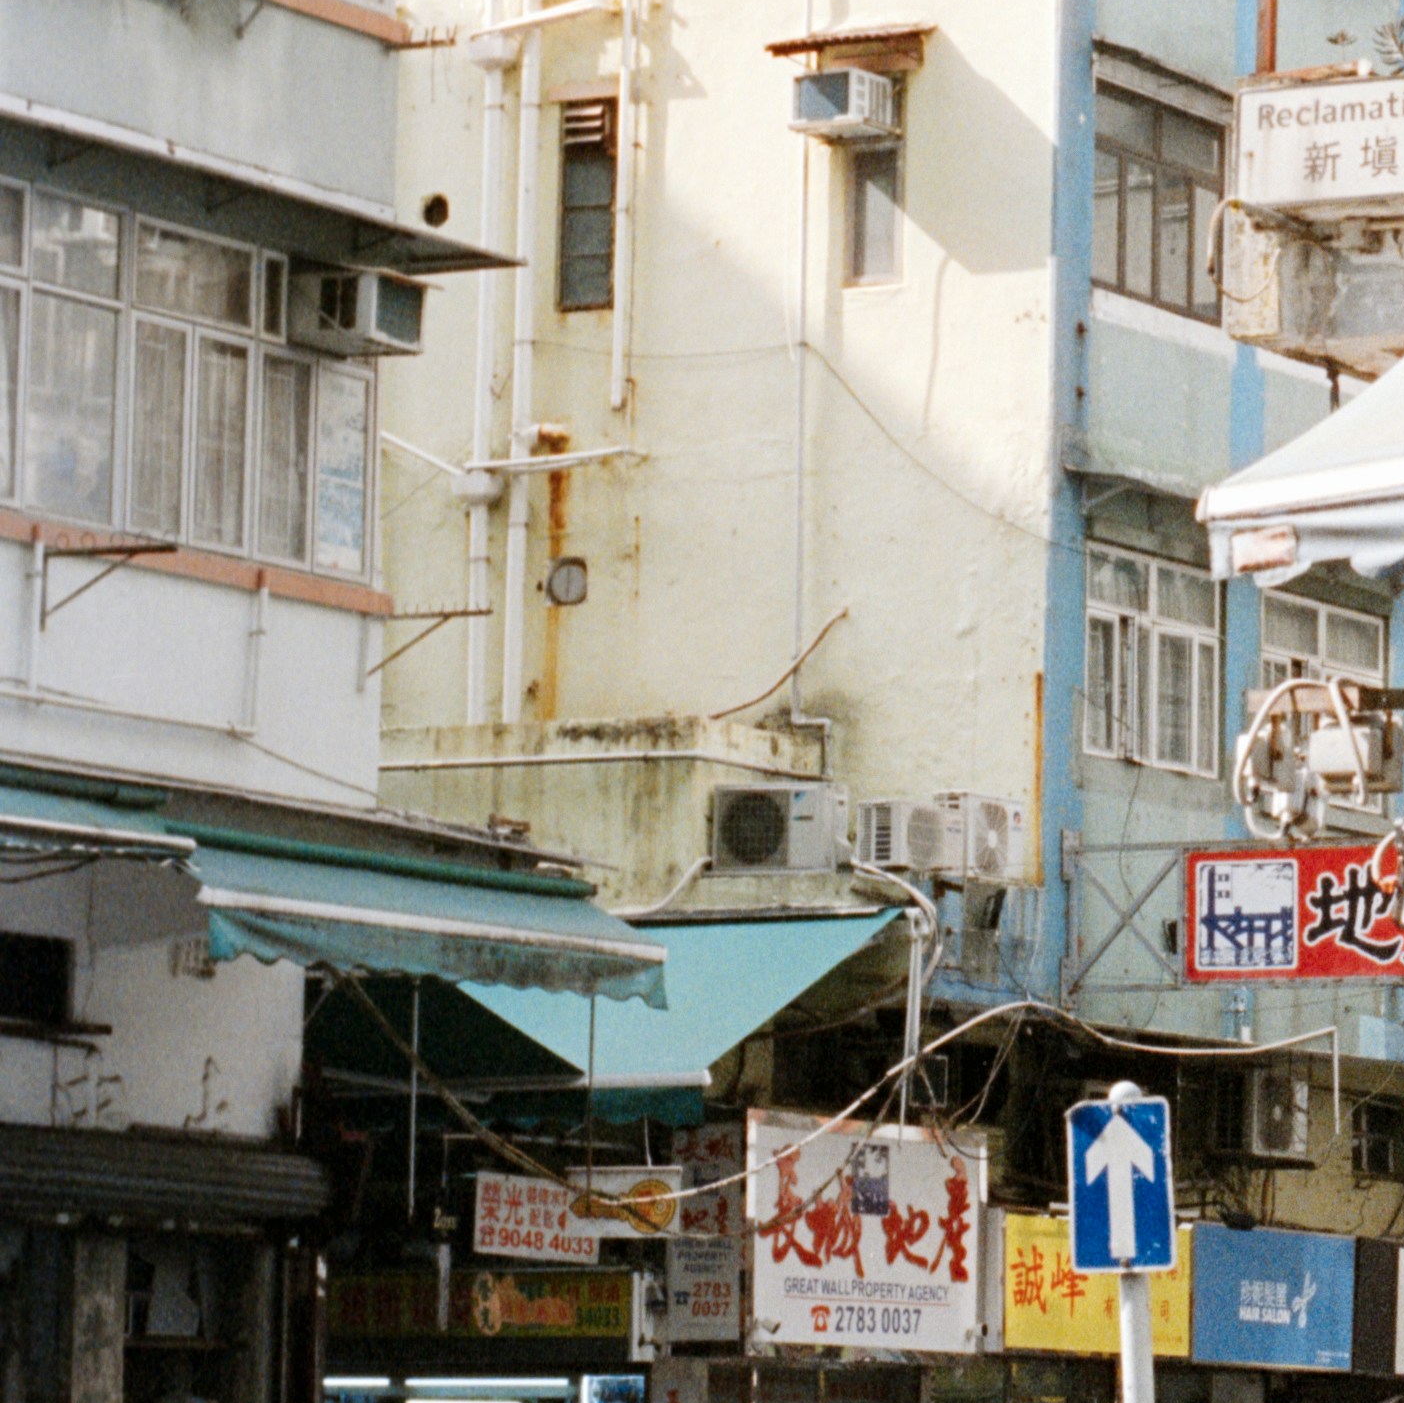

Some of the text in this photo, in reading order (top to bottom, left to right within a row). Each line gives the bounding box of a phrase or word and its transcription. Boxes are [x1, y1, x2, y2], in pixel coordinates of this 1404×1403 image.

[757, 1143, 971, 1284] 長城地產
[498, 1227, 595, 1257] 9048 4033
[692, 1282, 731, 1299] 2783
[784, 1277, 950, 1302] GREAT WALL PROPERTY AGENCY
[1010, 1244, 1089, 1319] 誠峰
[691, 1301, 731, 1317] 0037
[835, 1305, 922, 1334] 2783 0037
[1239, 1306, 1292, 1325] HAIR SALON
